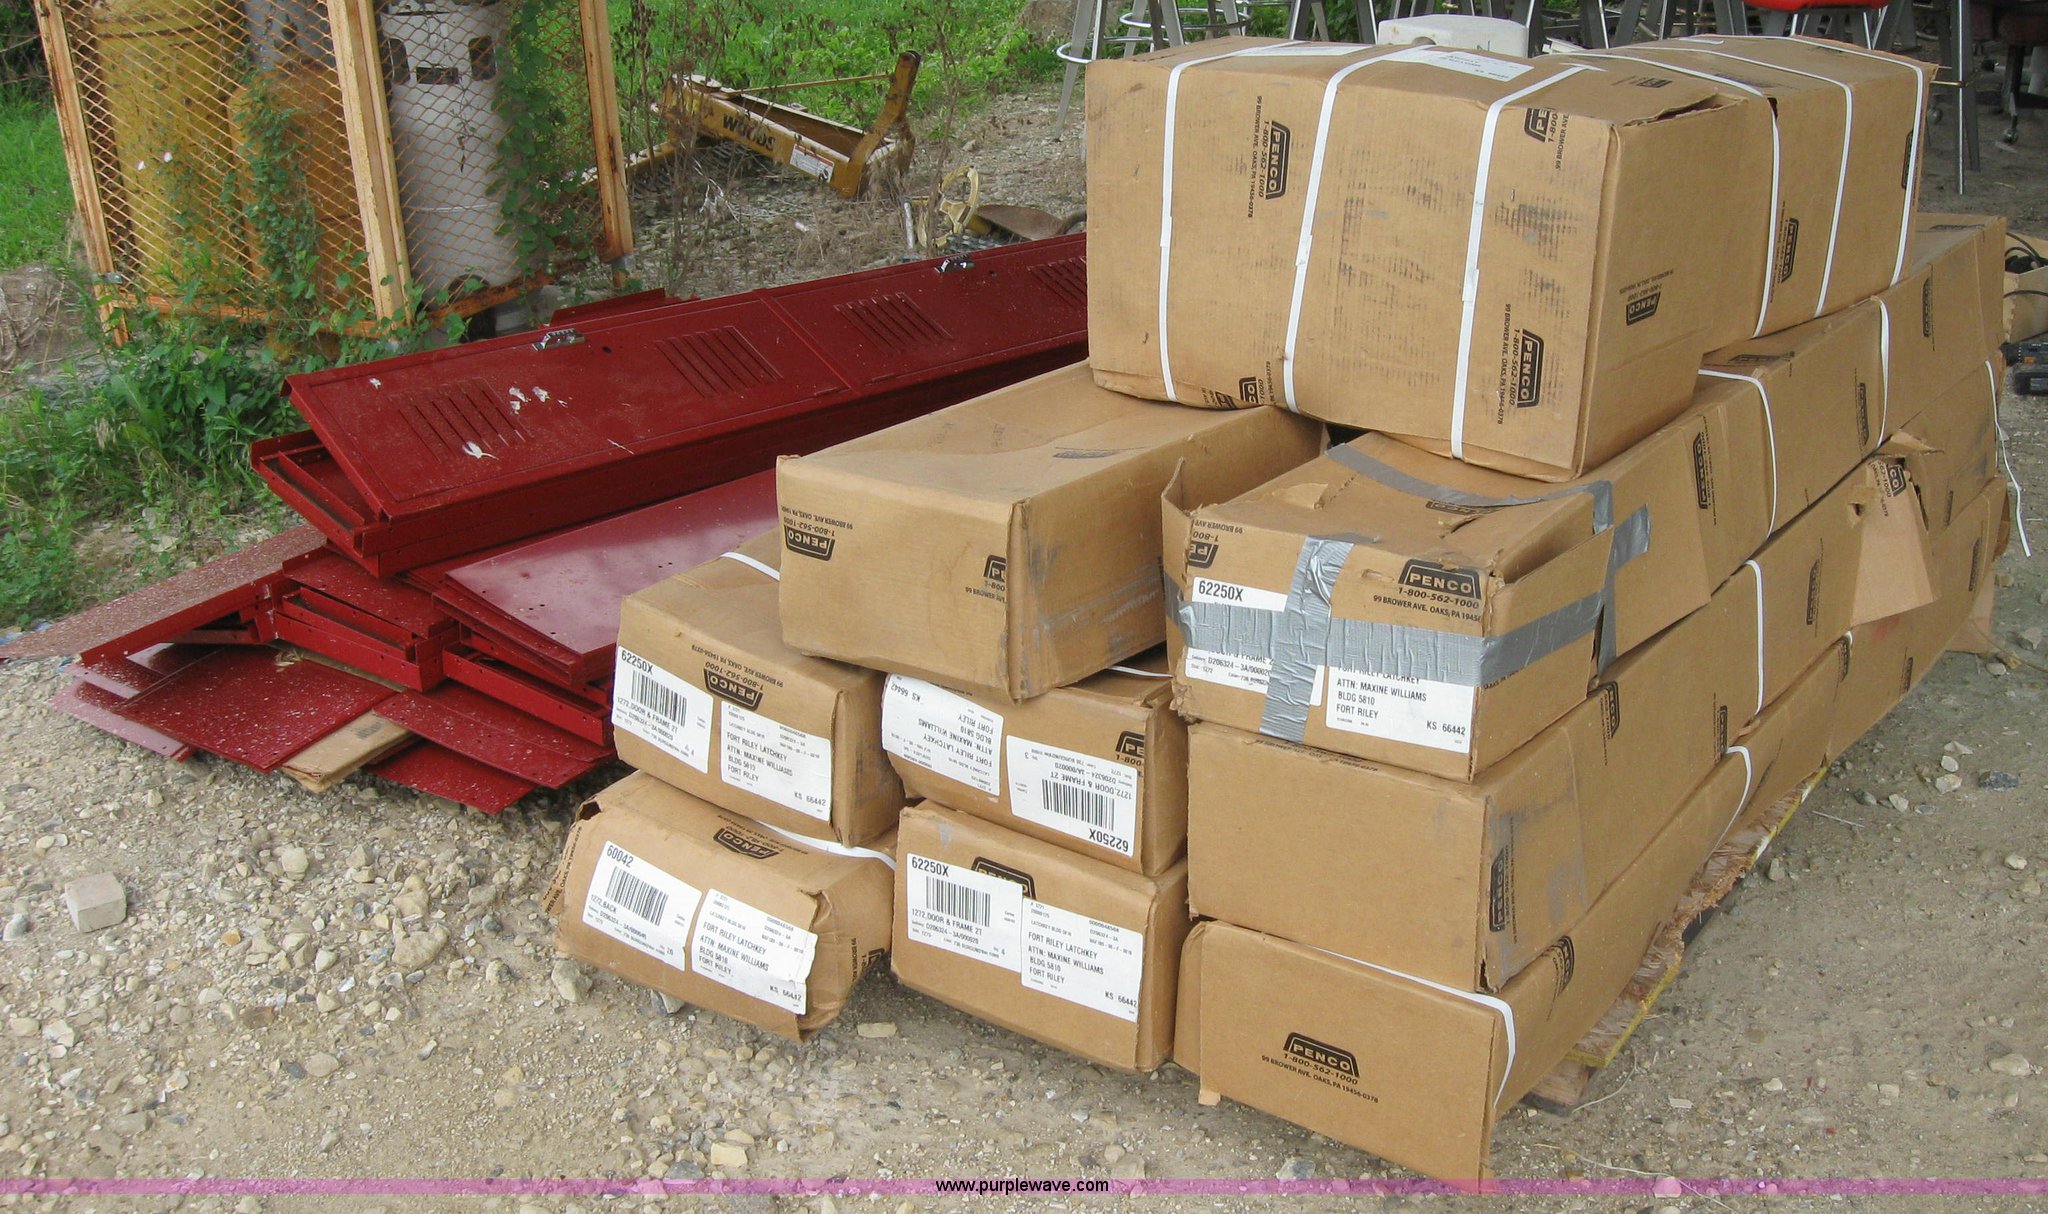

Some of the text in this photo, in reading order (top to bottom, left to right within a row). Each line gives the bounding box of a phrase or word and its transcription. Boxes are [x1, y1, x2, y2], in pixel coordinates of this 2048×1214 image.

[1259, 120, 1270, 198] 1-800-562-1000
[1268, 131, 1281, 191] PENCO
[1509, 328, 1520, 406] 1-800-562-1000
[1520, 340, 1533, 400] PENCO
[784, 516, 835, 537] 1-800-562-1000
[1207, 521, 1234, 533] BROWER
[788, 529, 827, 549] PENCO
[1198, 580, 1244, 602] 62250X
[1409, 572, 1472, 595] PENCO
[1382, 596, 1412, 609] BROWER
[1398, 587, 1480, 610] 1-800-562-1000
[621, 650, 654, 675] 62250X
[705, 661, 764, 691] 1-800-562-1000
[710, 675, 755, 700] PENCO
[890, 683, 921, 702] KS 66442
[1336, 678, 1428, 702] ATTN: MAXINE WILLIAMS
[1337, 691, 1376, 706] BLDG 5810
[1336, 703, 1379, 719] FORT RILEY
[958, 713, 993, 735] FORT RILEY
[960, 725, 992, 745] BLDG 5810
[1426, 720, 1466, 736] KS 66442
[727, 731, 788, 761] FORT RILEY LATCHKEY
[918, 718, 993, 756] ATTN: MAXINE WILLIAMS
[727, 744, 742, 756] ATTN:
[728, 755, 742, 767] BLDG
[923, 733, 992, 768] FORT RILEY LATCHKEY
[727, 764, 759, 782] FORT RILEY
[1061, 774, 1086, 786] FRAME
[806, 796, 827, 807] 66442
[723, 832, 771, 855] PENCO
[1088, 828, 1129, 852] 62250X
[606, 844, 635, 868] 60042
[911, 856, 949, 877] 62250X
[703, 921, 767, 956] FORT RILEY LATCHKEY
[952, 920, 973, 933] FRAME
[975, 927, 982, 936] 2T
[700, 945, 714, 958] BLDG
[1028, 931, 1098, 960] FORT RILEY LATCHKEY
[717, 942, 739, 957] MAXINE
[740, 951, 769, 972] WILLIAMS
[1028, 945, 1104, 975] ATTN: MAXINE WILLIAMS
[1030, 956, 1061, 973] BLDG 5810
[1029, 967, 1065, 985] FORT RILEY
[1105, 990, 1137, 1008] KS 66442
[1270, 1058, 1297, 1073] BROWER
[1293, 1043, 1351, 1071] PENCO
[1284, 1053, 1359, 1085] 1-800-562-1000
